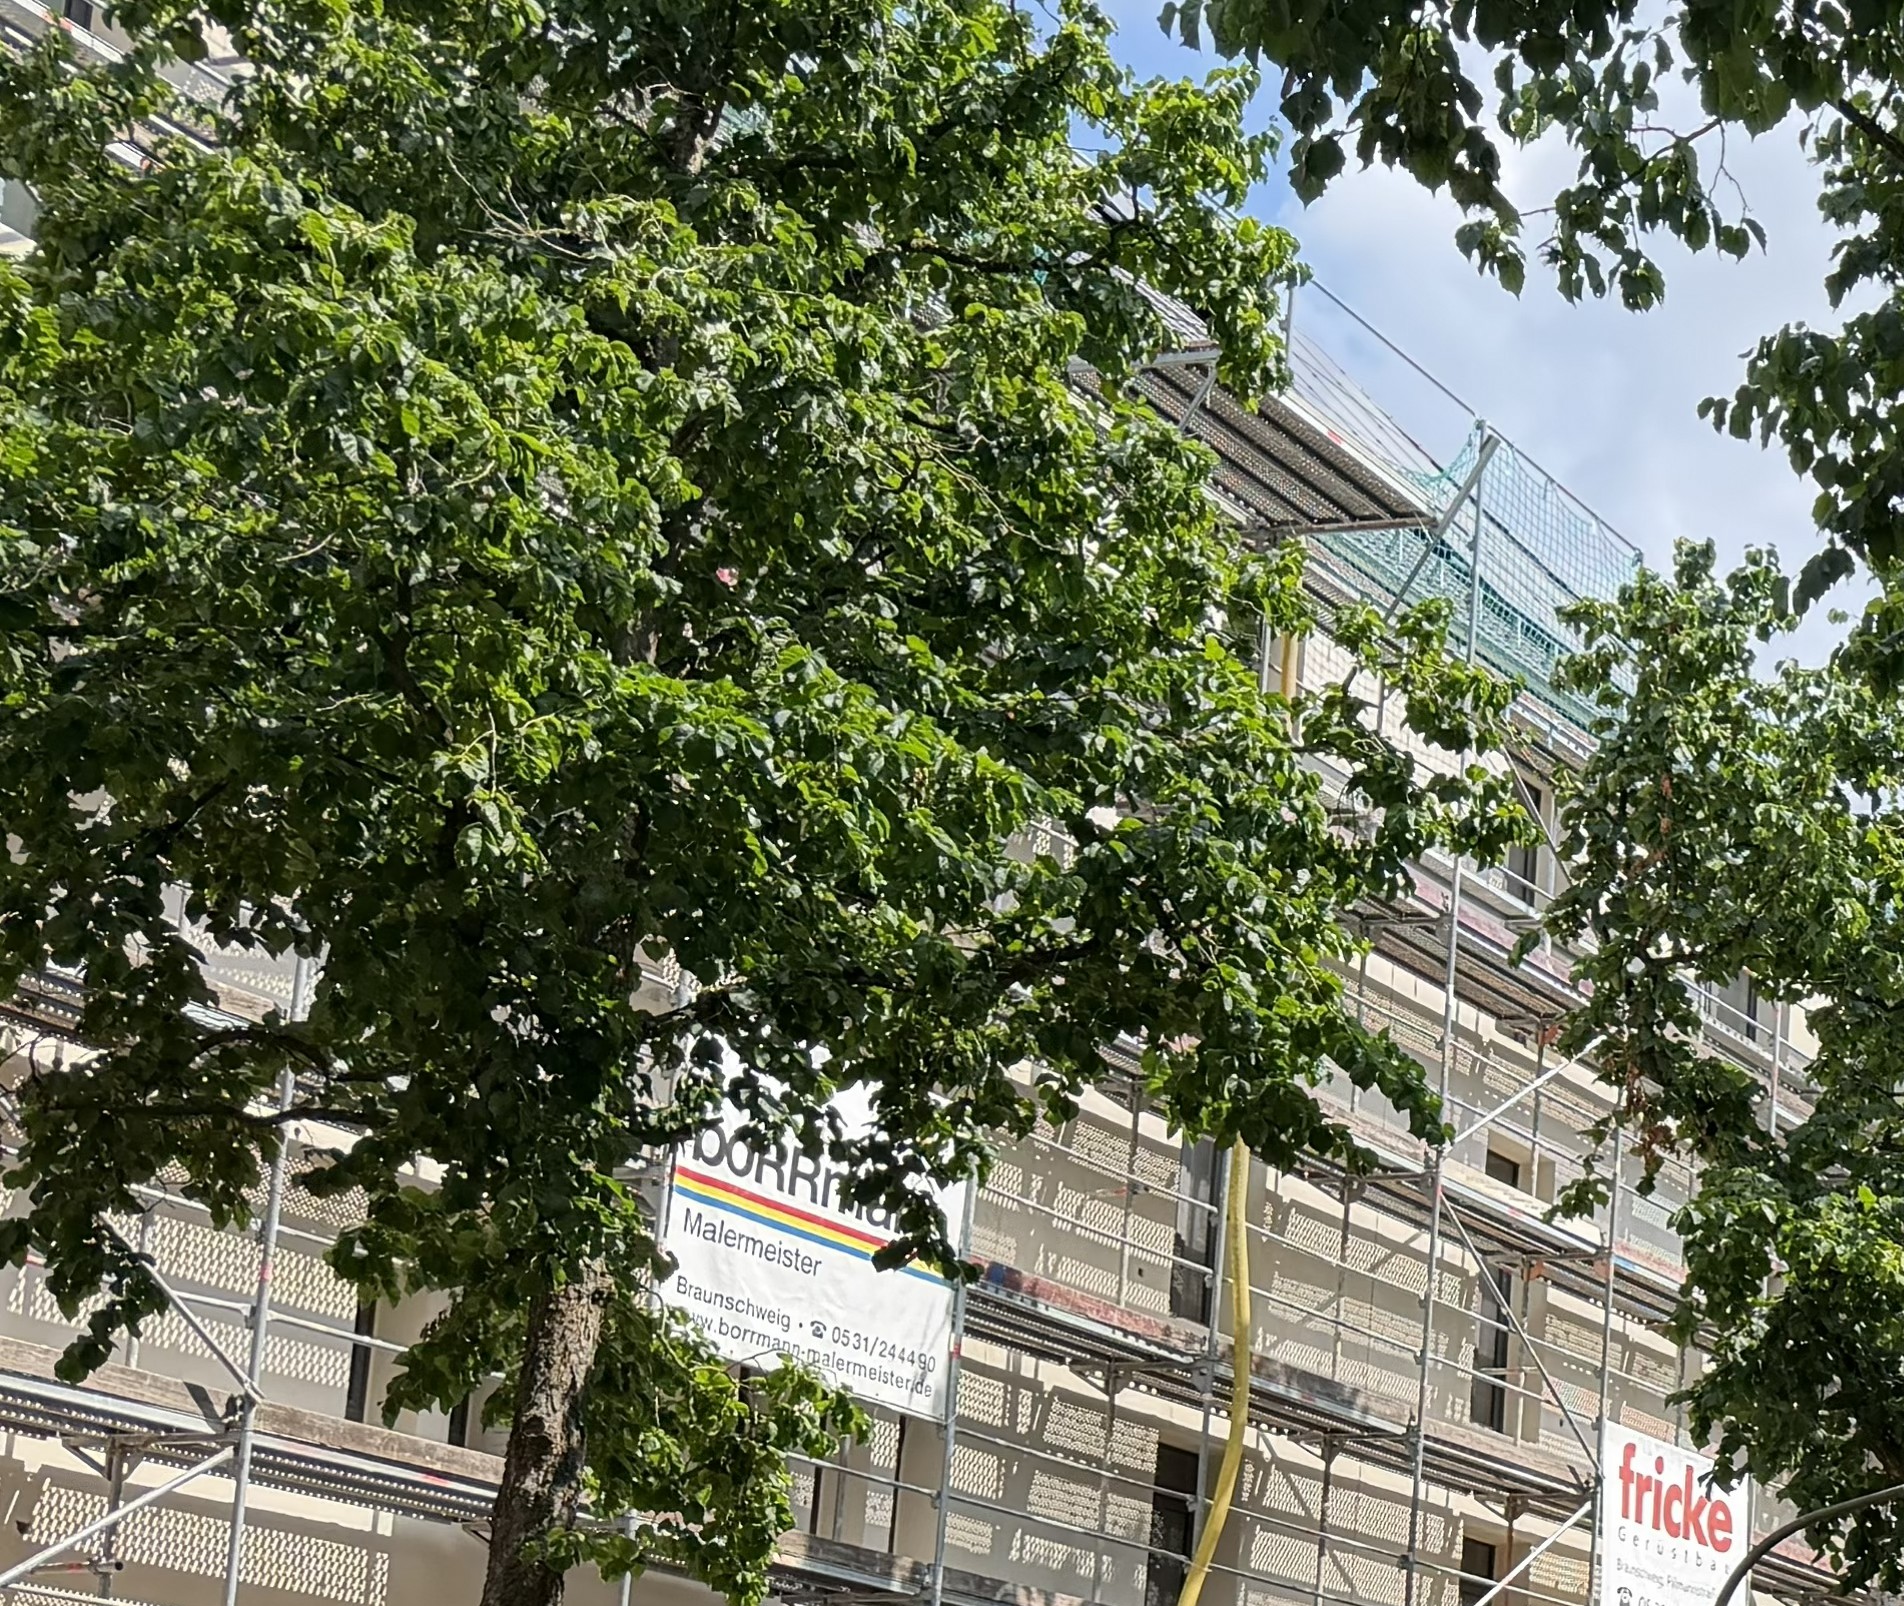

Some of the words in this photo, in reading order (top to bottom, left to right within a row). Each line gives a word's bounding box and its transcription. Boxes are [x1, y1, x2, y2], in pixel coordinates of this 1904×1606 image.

[682, 1206, 823, 1278] Malermeister
[676, 1275, 791, 1333] Braunschweig
[831, 1326, 936, 1373] 0531/244490
[1619, 1442, 1733, 1553] fricke
